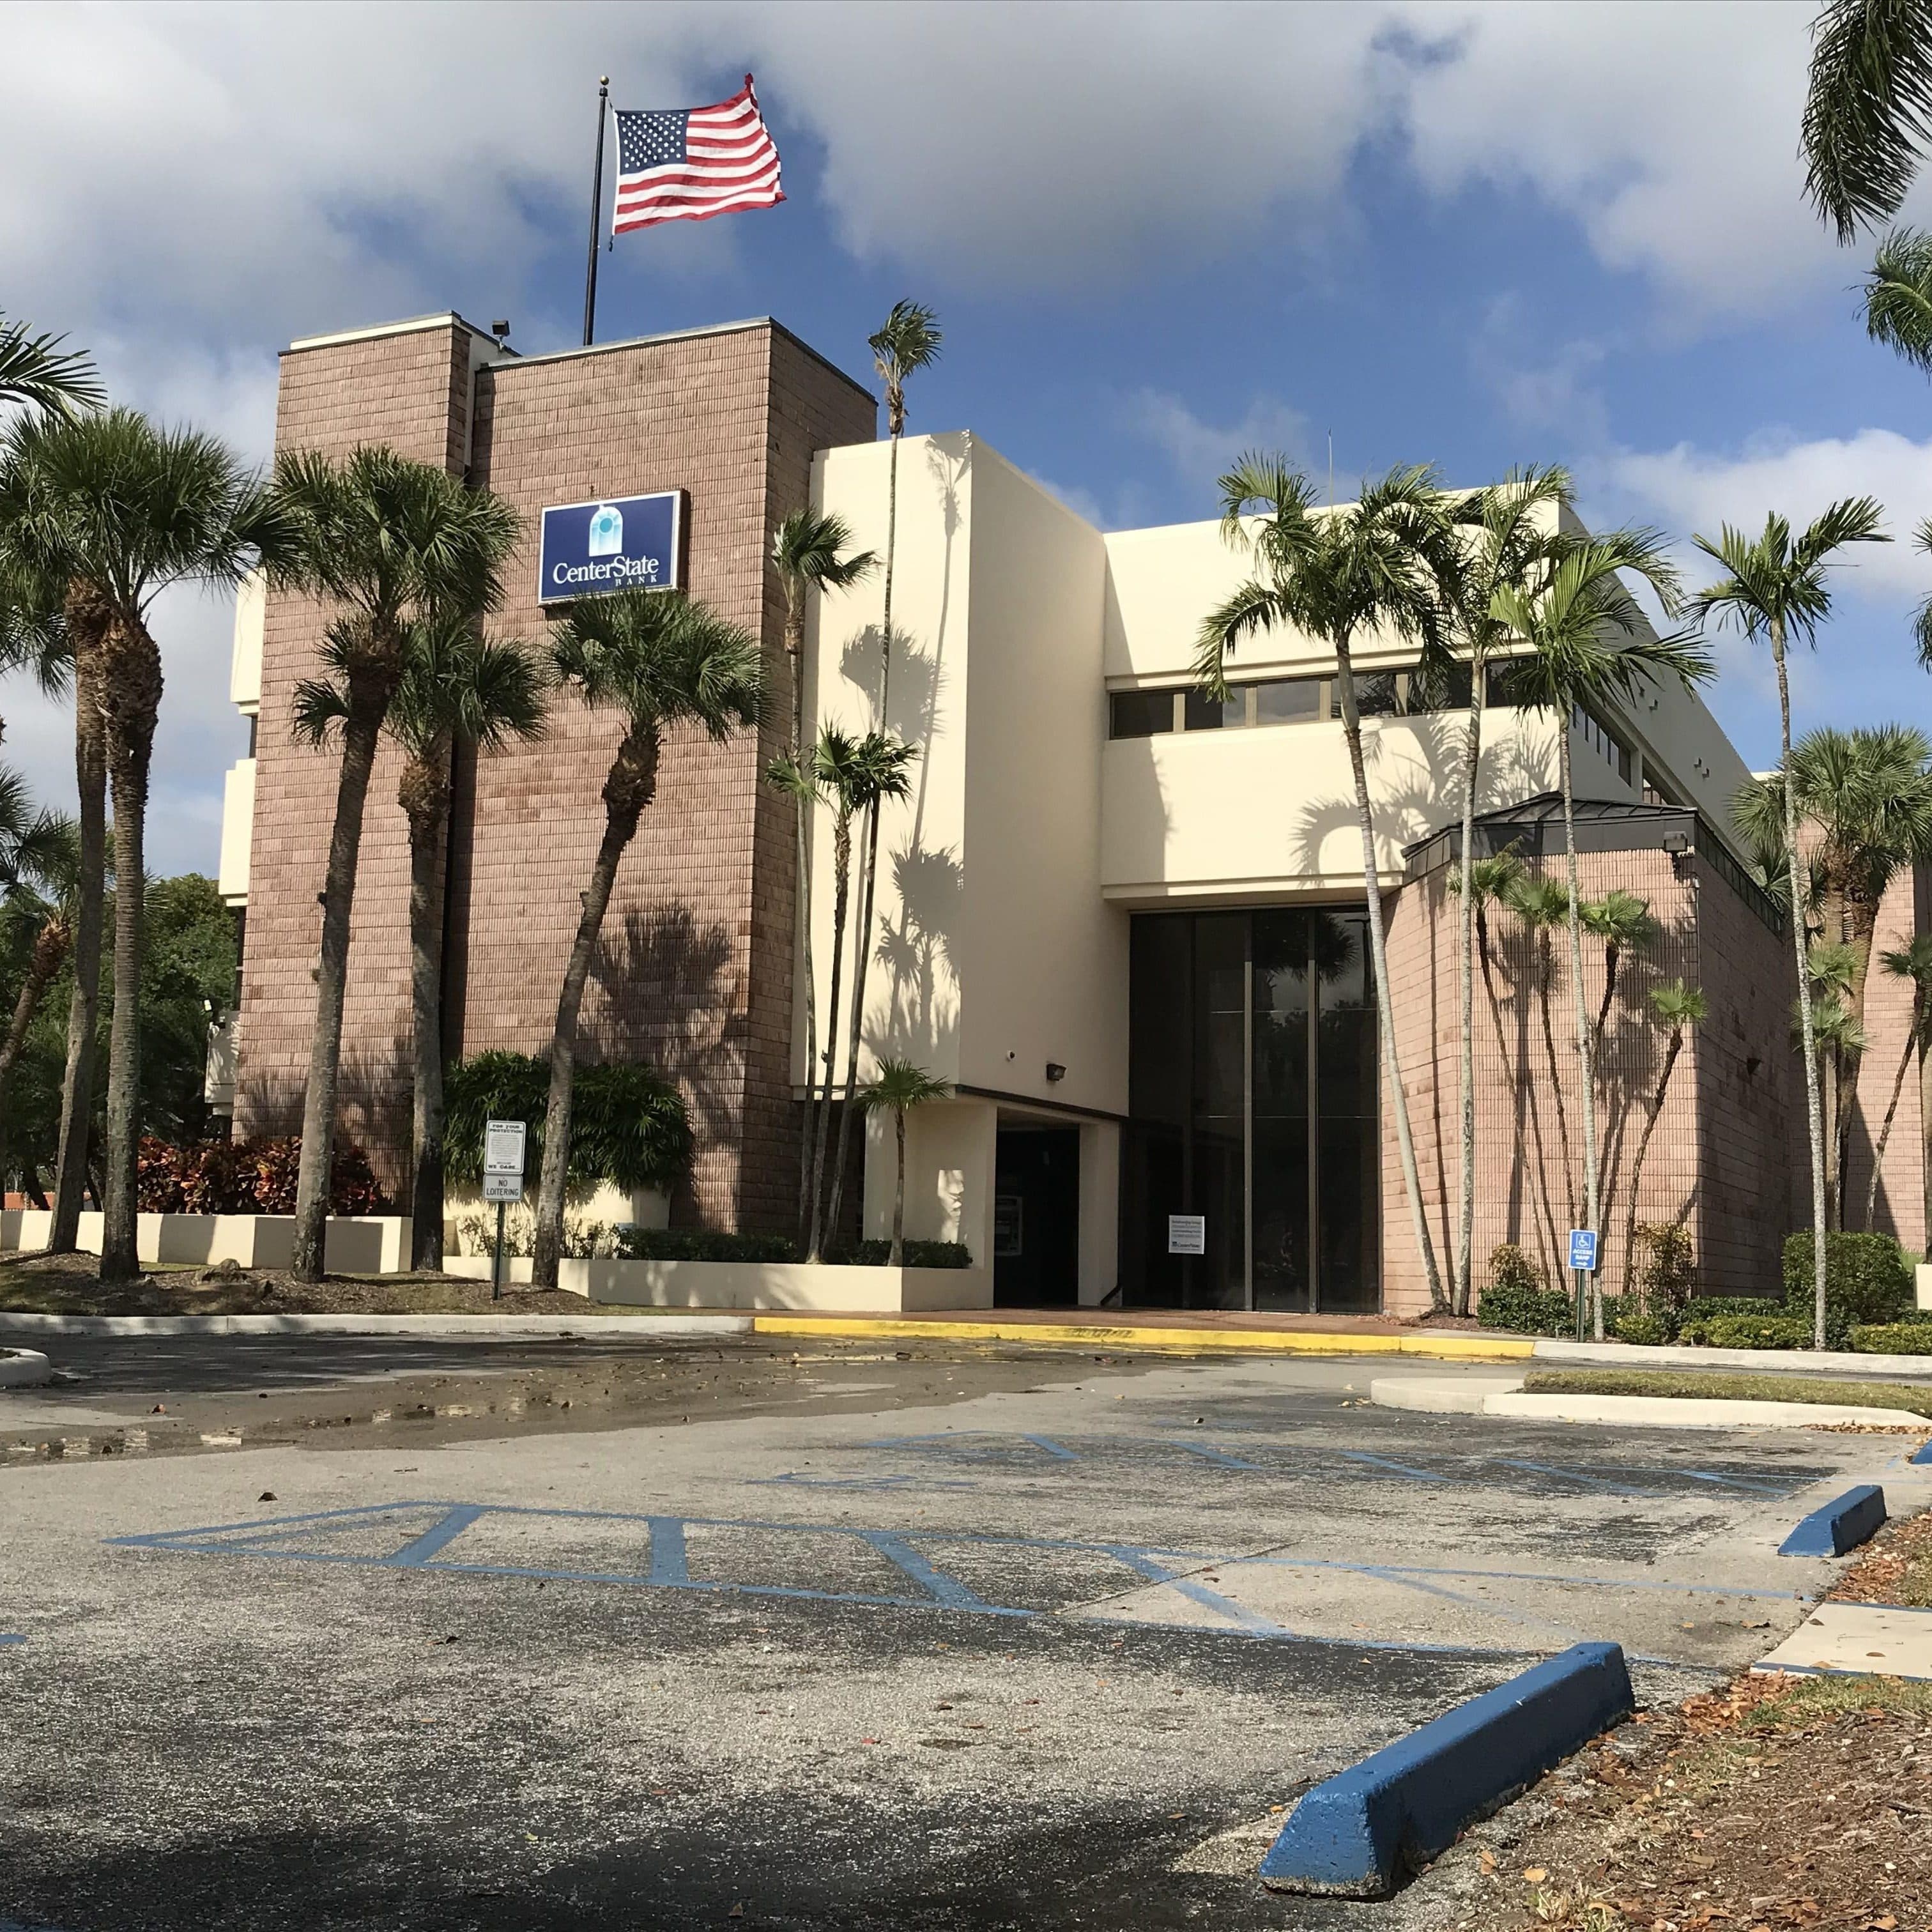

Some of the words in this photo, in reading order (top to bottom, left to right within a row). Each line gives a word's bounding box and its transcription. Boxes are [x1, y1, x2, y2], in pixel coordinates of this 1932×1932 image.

[553, 555, 659, 585] CenterState
[615, 574, 657, 586] BANK
[486, 1188, 519, 1197] LOITERING
